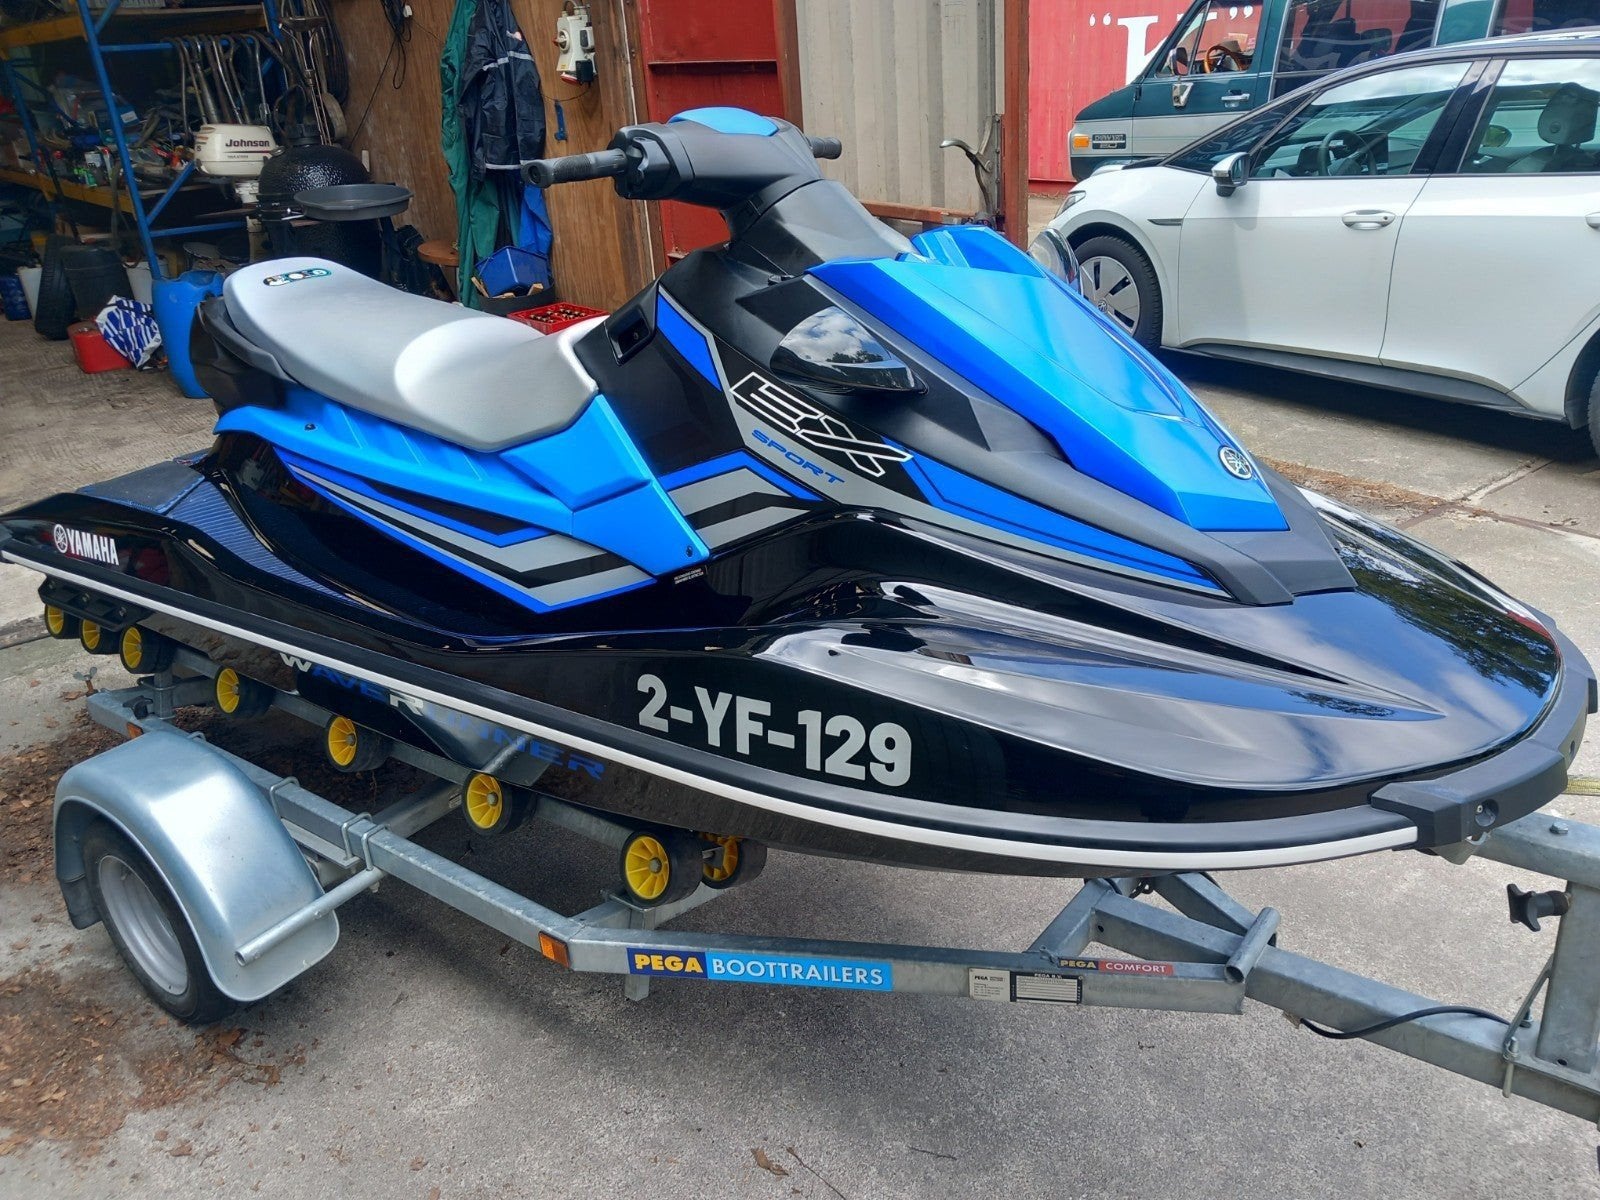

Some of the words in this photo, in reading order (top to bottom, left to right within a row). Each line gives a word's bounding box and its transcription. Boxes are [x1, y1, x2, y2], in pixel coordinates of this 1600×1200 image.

[225, 139, 270, 147] Johnson
[729, 371, 915, 478] EX
[751, 429, 846, 484] SPORT
[66, 528, 120, 566] YAMAHA
[637, 673, 912, 787] 2-YF-129
[634, 954, 704, 974] PEGA
[712, 958, 883, 986] BOOTTRAILERS
[1060, 960, 1097, 969] PEGA
[1105, 962, 1167, 973] COMFORT
